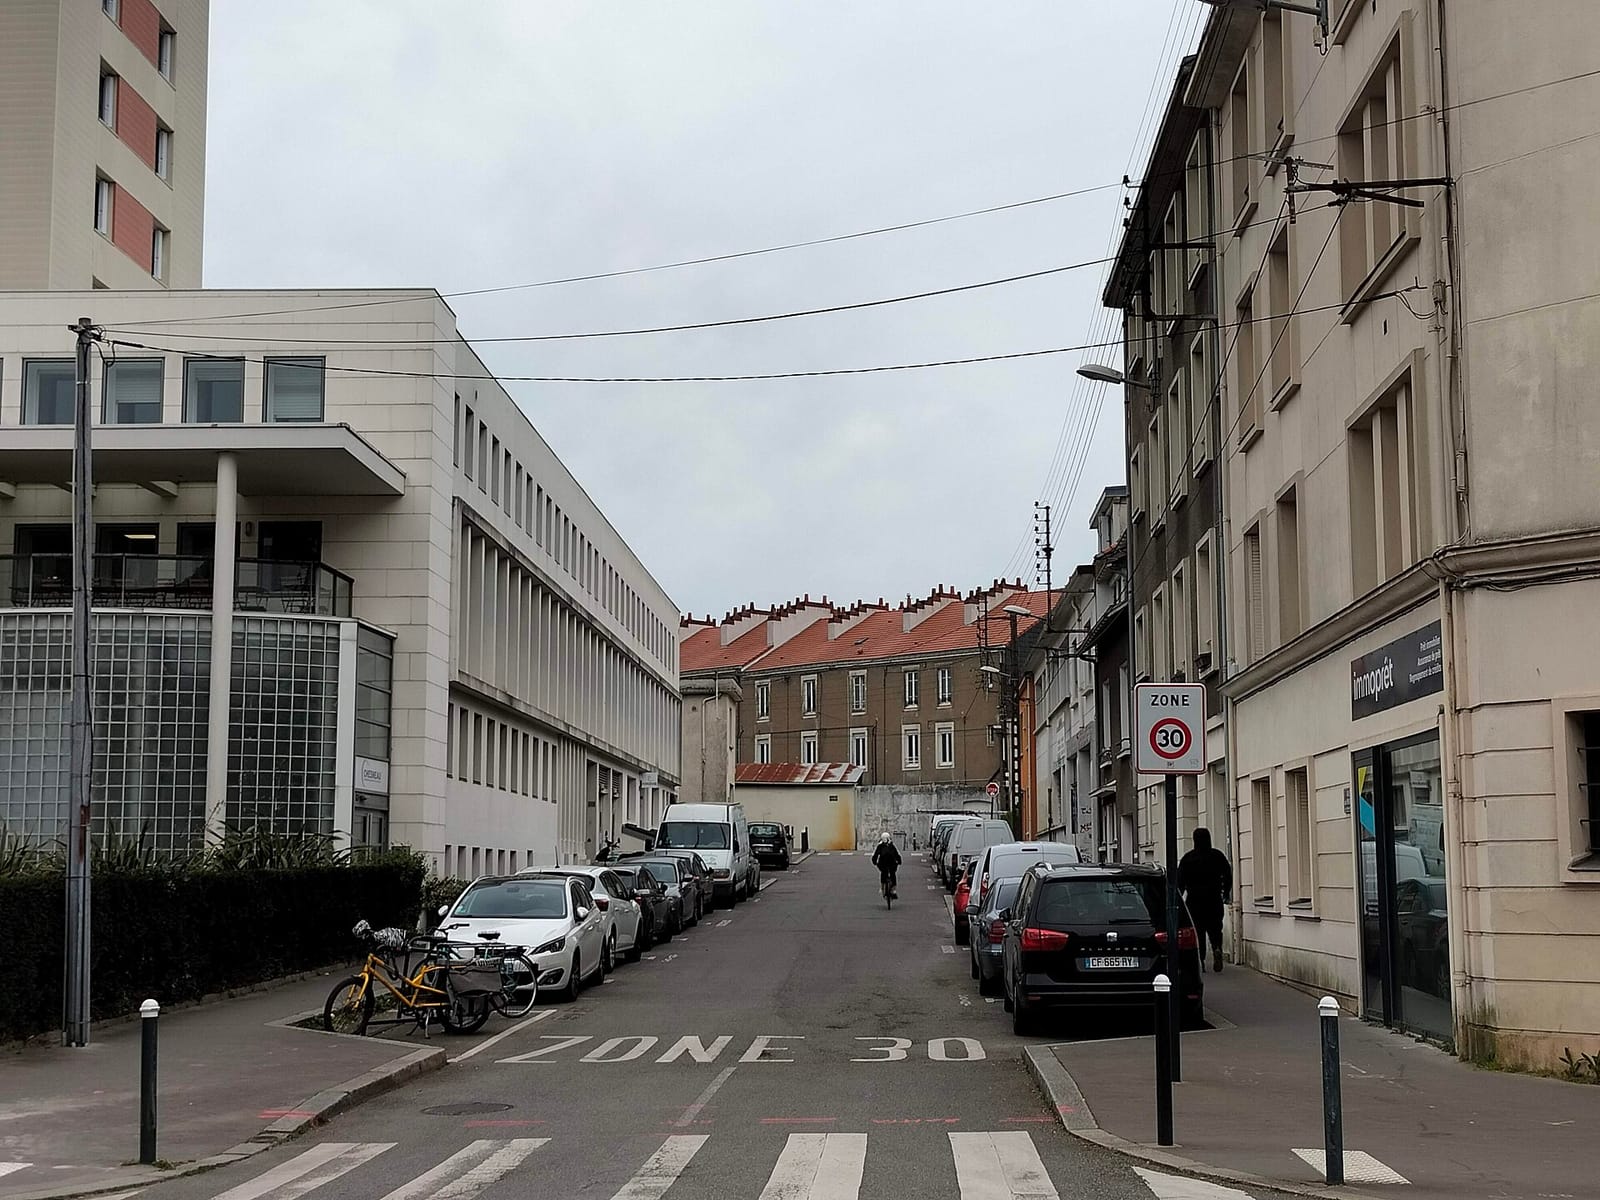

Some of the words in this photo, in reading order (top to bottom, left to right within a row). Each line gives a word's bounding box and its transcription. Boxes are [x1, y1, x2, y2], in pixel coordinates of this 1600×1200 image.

[1353, 656, 1394, 702] immoprêt
[1150, 694, 1190, 707] ZONE
[1157, 728, 1184, 748] 30
[1091, 958, 1102, 967] CF
[1104, 957, 1120, 967] 665
[494, 1036, 806, 1064] ZONE
[850, 1037, 987, 1063] 30
